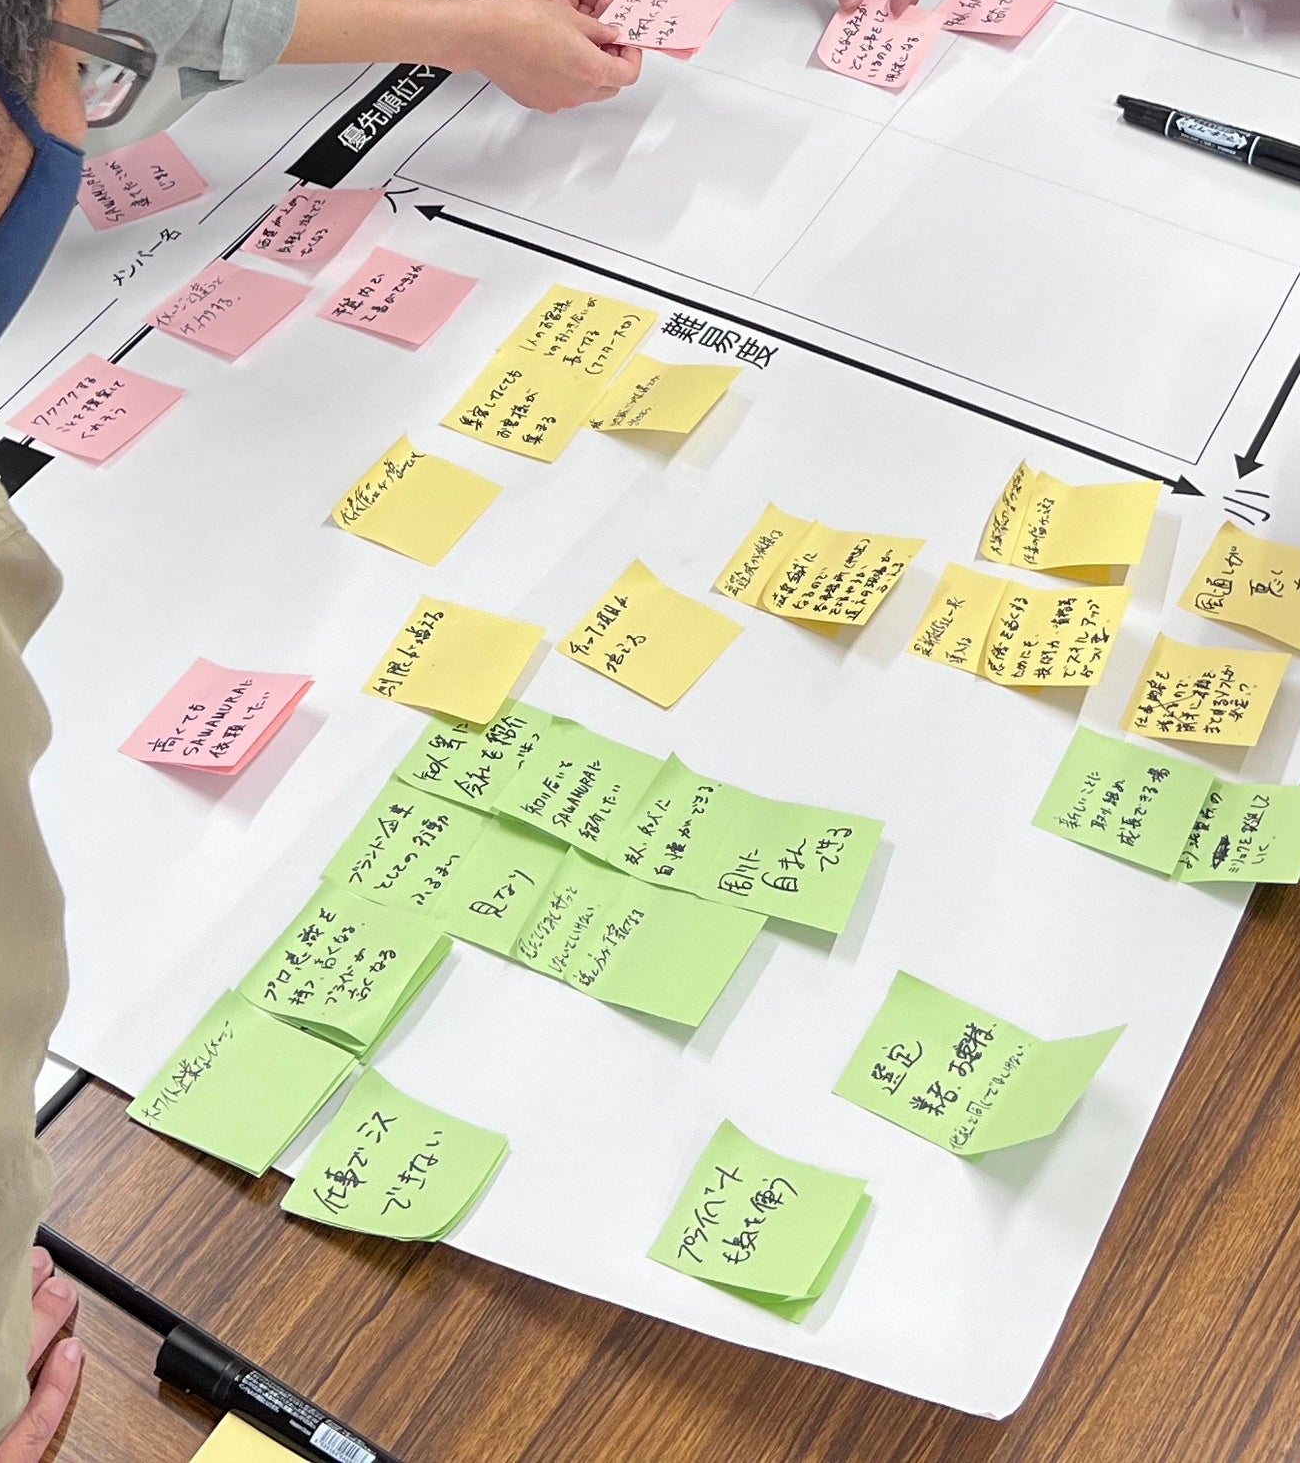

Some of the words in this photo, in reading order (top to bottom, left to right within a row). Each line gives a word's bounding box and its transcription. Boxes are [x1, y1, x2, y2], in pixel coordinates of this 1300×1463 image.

[848, 9, 896, 71] どんな事をして
[867, 37, 894, 78] いるのか
[884, 36, 920, 83] 明確になる
[150, 165, 176, 191] じまん
[112, 228, 183, 287] メンバー名
[562, 329, 600, 367] 長くなる
[660, 311, 780, 370] 難易度
[30, 376, 97, 426] ワクワクする
[56, 380, 126, 433] ことを提案して
[80, 407, 127, 440] くれそう
[458, 369, 524, 432] 集客しなくても
[495, 388, 539, 439] お客様が
[521, 416, 557, 446] 集まる
[1223, 488, 1271, 527] 小
[791, 566, 829, 610] なるので
[1194, 545, 1244, 615] 風通しが
[1062, 598, 1100, 679] でスキルアップ
[146, 703, 206, 753] 高くても
[182, 679, 253, 757] SAWAMURAに
[208, 691, 270, 759] 依頼したい
[453, 715, 528, 799] 会社を紹介
[551, 759, 602, 829] SAWAMURAに
[577, 784, 621, 843] 紹介したい
[1058, 771, 1102, 830] 新しいことに
[1116, 767, 1171, 847] 成長できる場
[348, 803, 415, 884] ブランド企業
[372, 814, 450, 890] としての行動
[716, 848, 761, 897] 周りに
[760, 837, 807, 893] 自まん
[814, 827, 853, 873] できる
[410, 854, 461, 906] ふるまい
[263, 907, 337, 1002] プロ意識を
[324, 947, 367, 1006] プライドが
[347, 949, 397, 1003] 高くなる
[141, 1020, 234, 1121] ホワイト企業なイメージ
[870, 1040, 923, 1096] 選定
[312, 1111, 398, 1215] 仕事でミス
[380, 1130, 443, 1216] できない
[677, 1165, 744, 1264] プライベート
[721, 1177, 799, 1266] も気を使う
